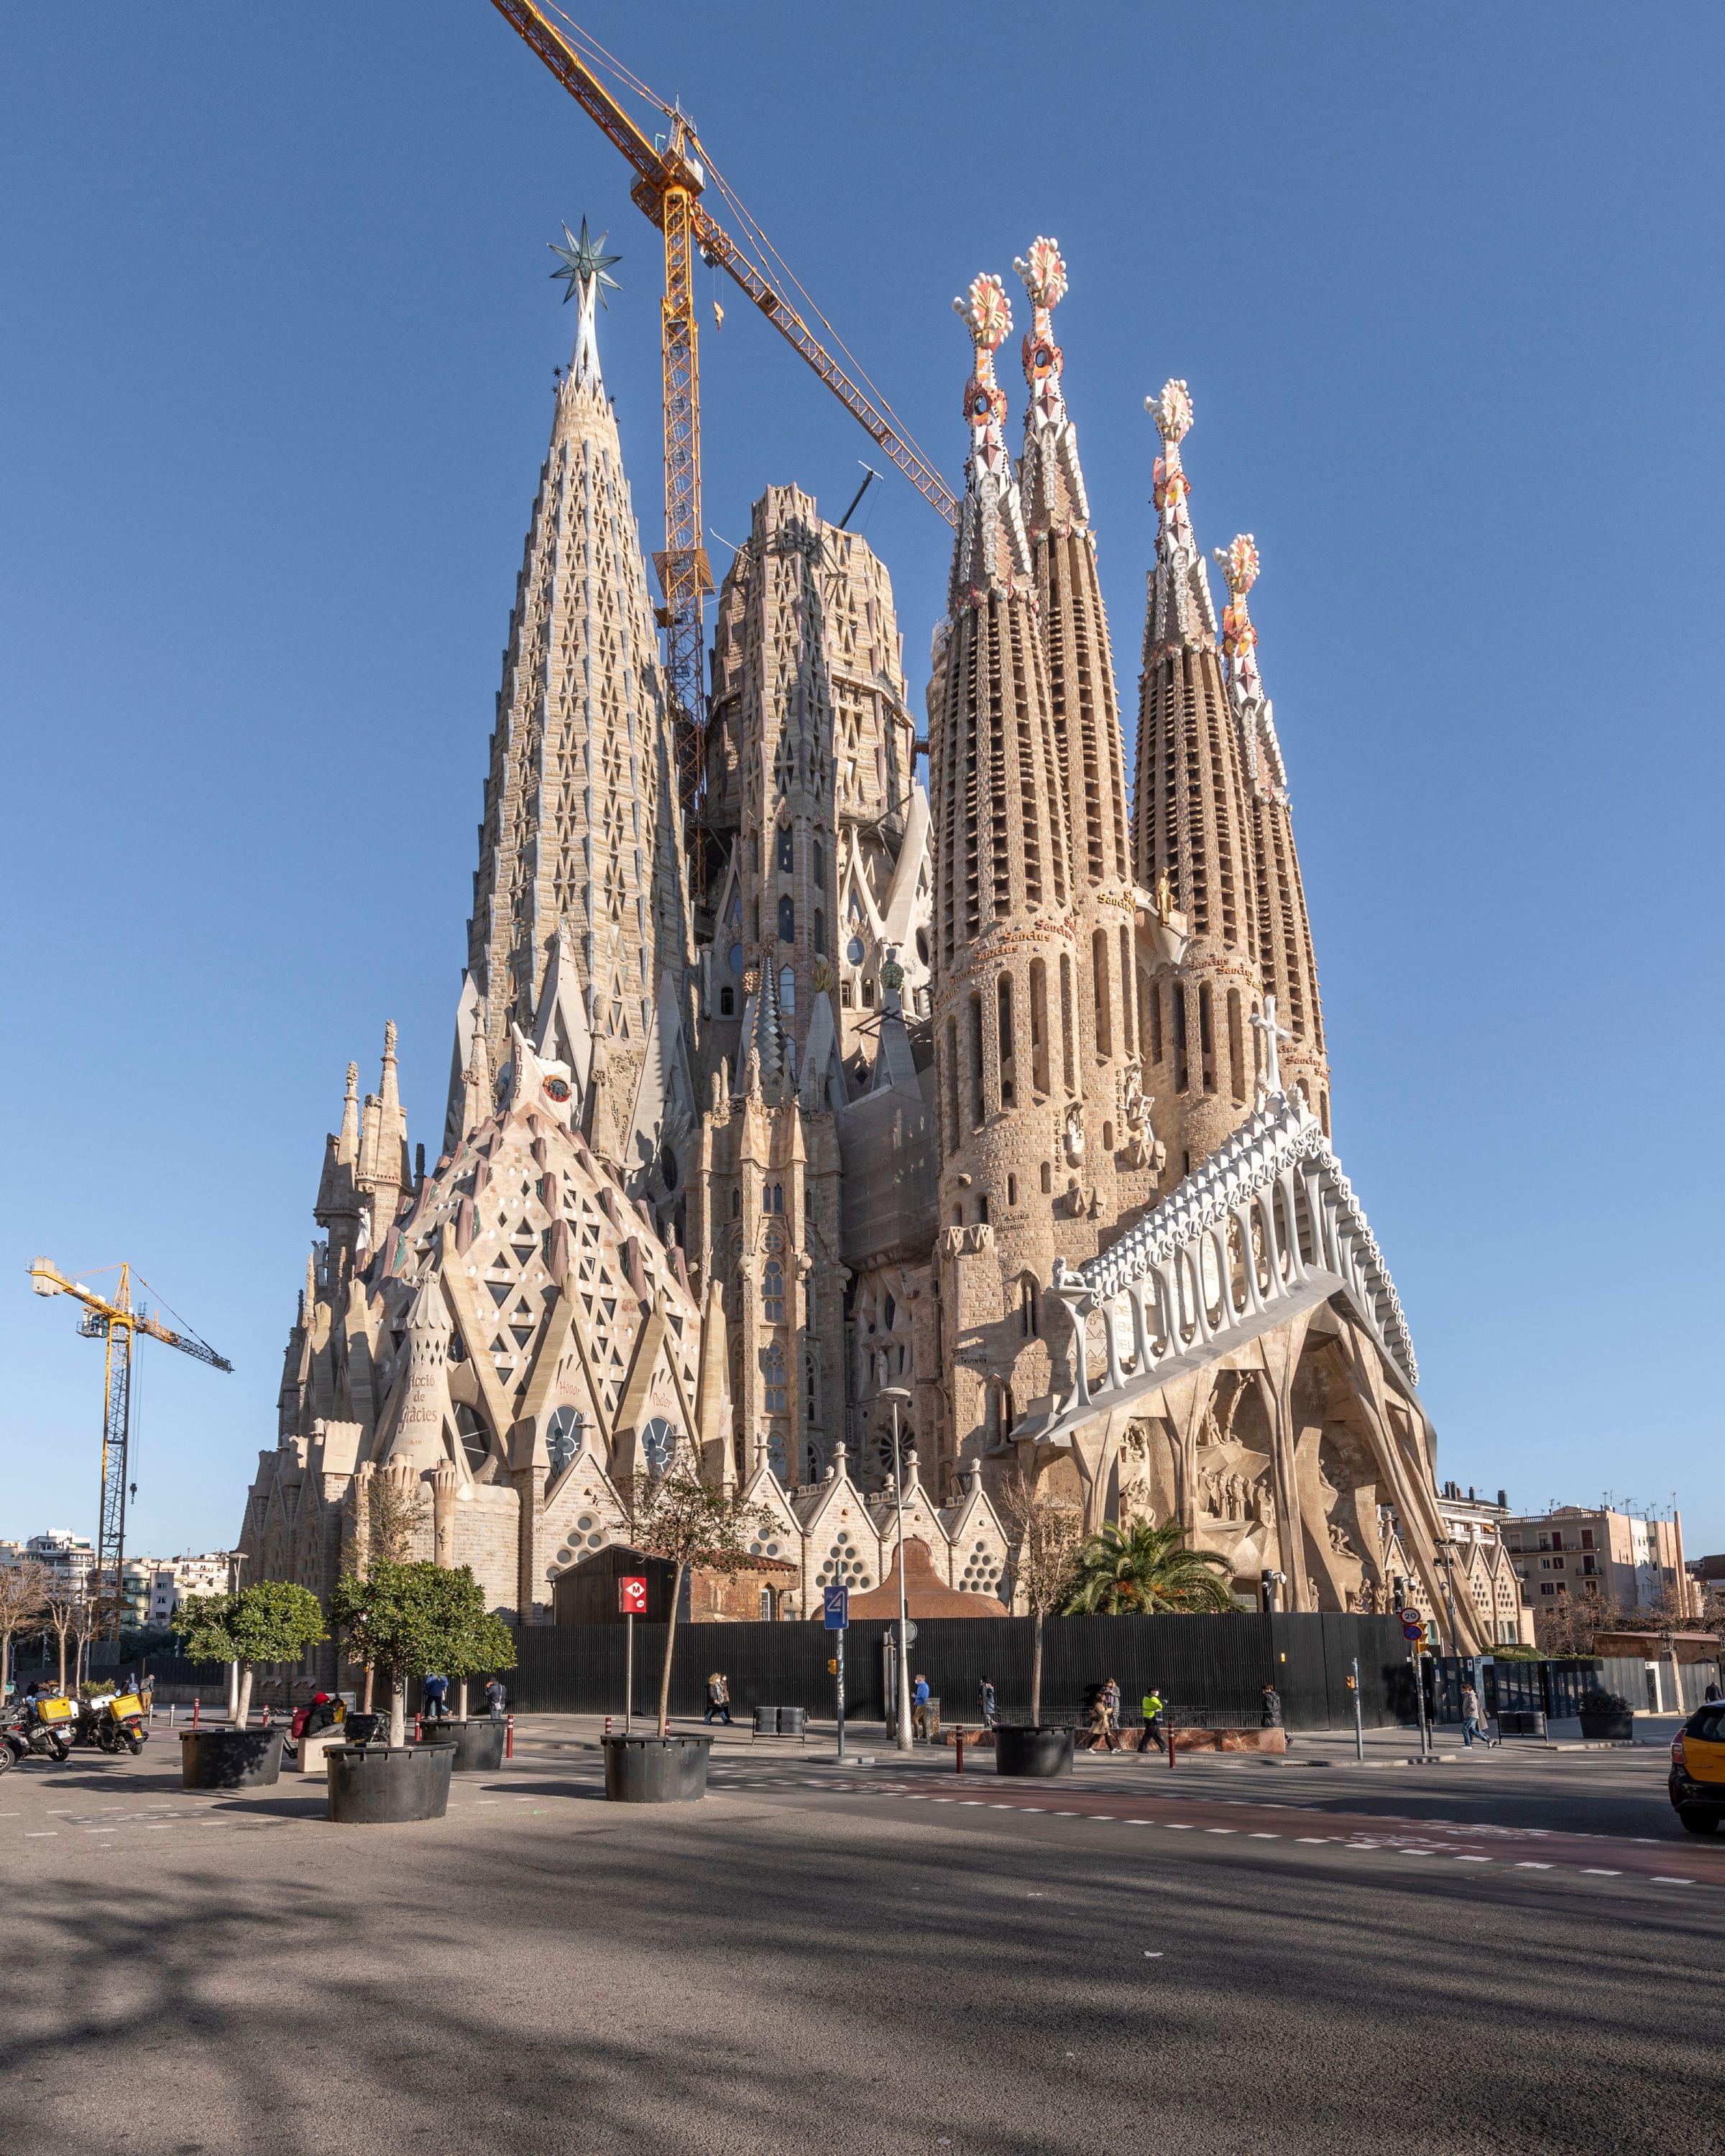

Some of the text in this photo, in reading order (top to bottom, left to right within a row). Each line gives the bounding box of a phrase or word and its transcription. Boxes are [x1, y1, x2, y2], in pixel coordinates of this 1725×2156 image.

[1004, 930, 1052, 943] Sanctus
[1037, 919, 1074, 941] Sanctus
[974, 944, 1020, 961] Sanctus
[1219, 965, 1254, 977] Sanctus
[413, 1391, 426, 1402] de
